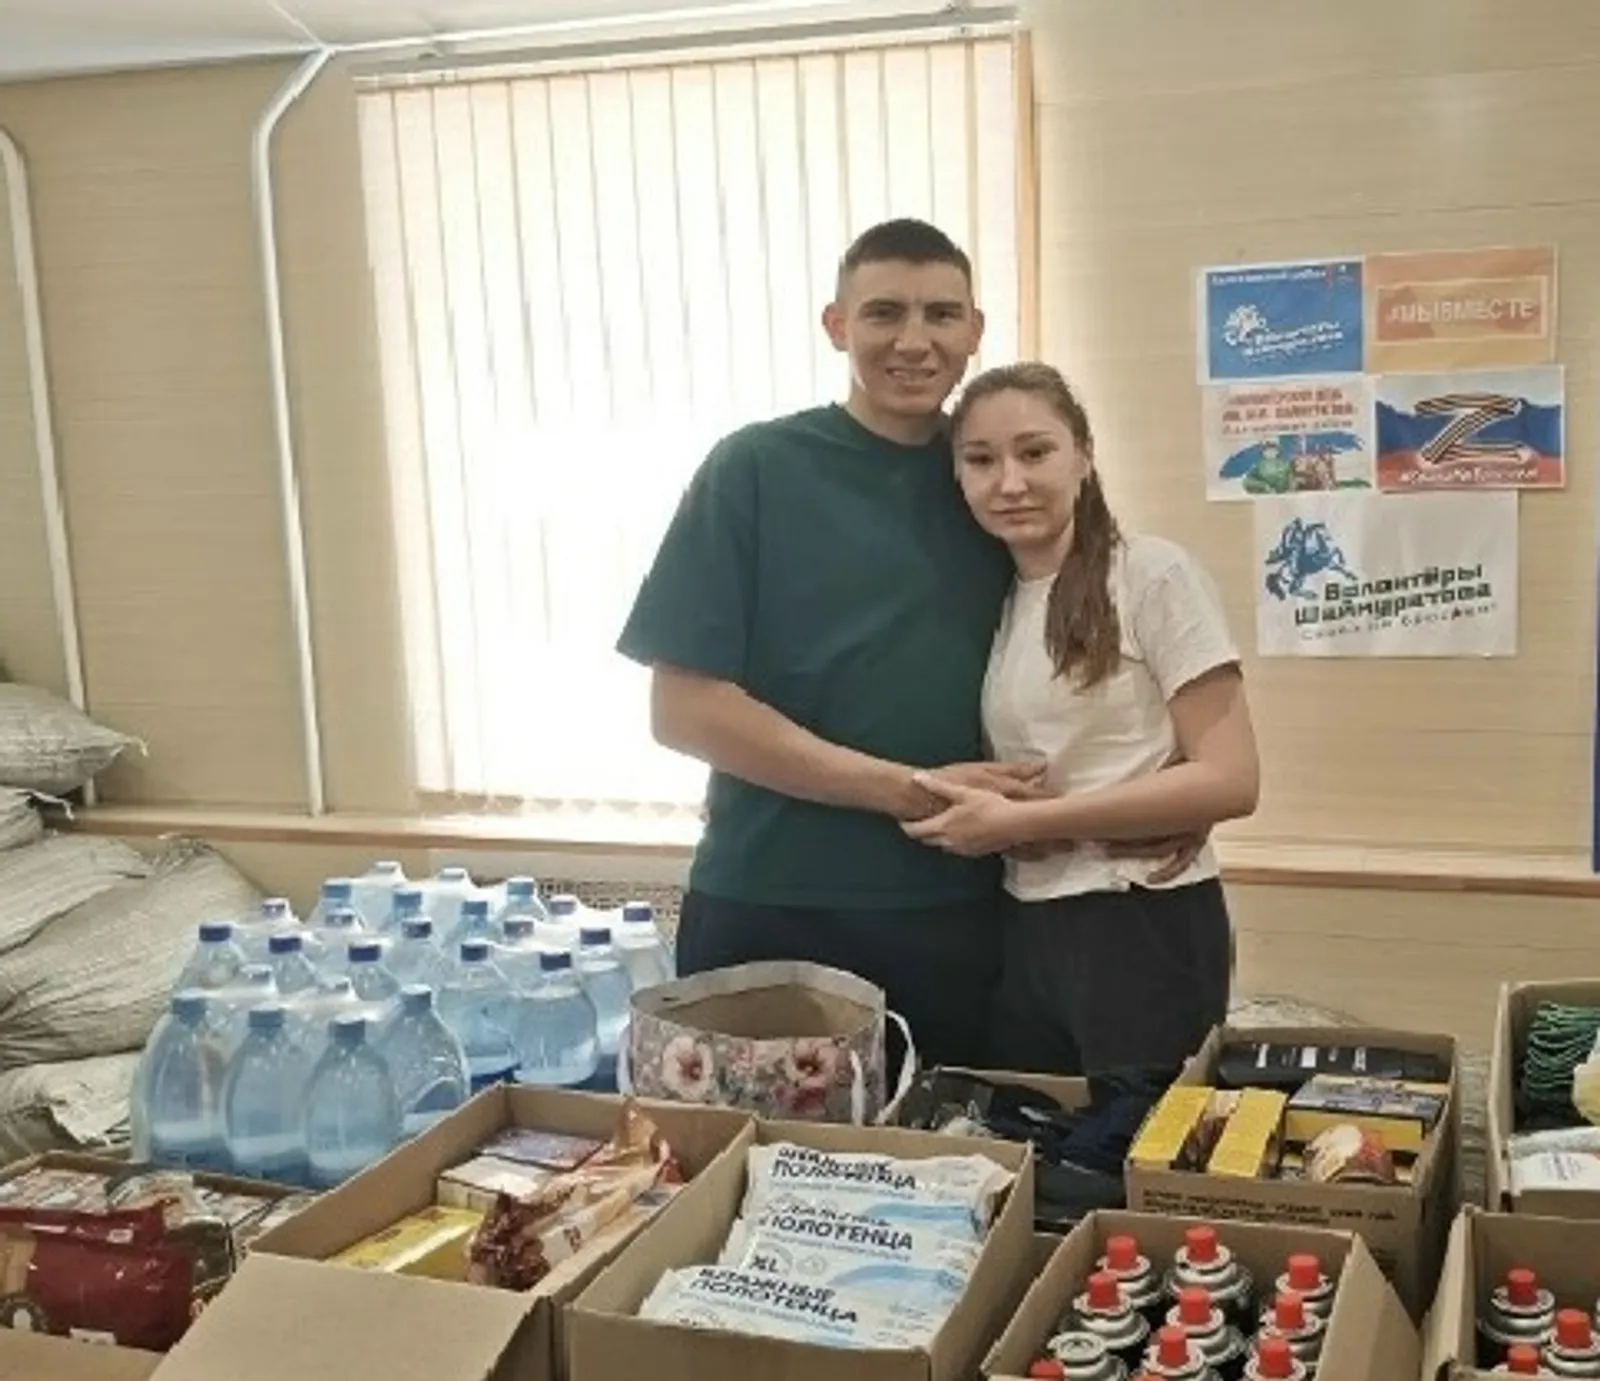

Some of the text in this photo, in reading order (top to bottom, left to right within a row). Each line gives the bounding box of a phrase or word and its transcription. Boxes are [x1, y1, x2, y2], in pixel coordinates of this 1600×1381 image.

[1414, 393, 1534, 464] Z
[1324, 564, 1483, 601] Волонтёры
[1294, 583, 1493, 626] Шаймуратова
[759, 1215, 913, 1250] ПОЛОТЕНЦА
[750, 1254, 778, 1273] XL
[690, 1279, 858, 1323] ПОЛОТЕНЦА
